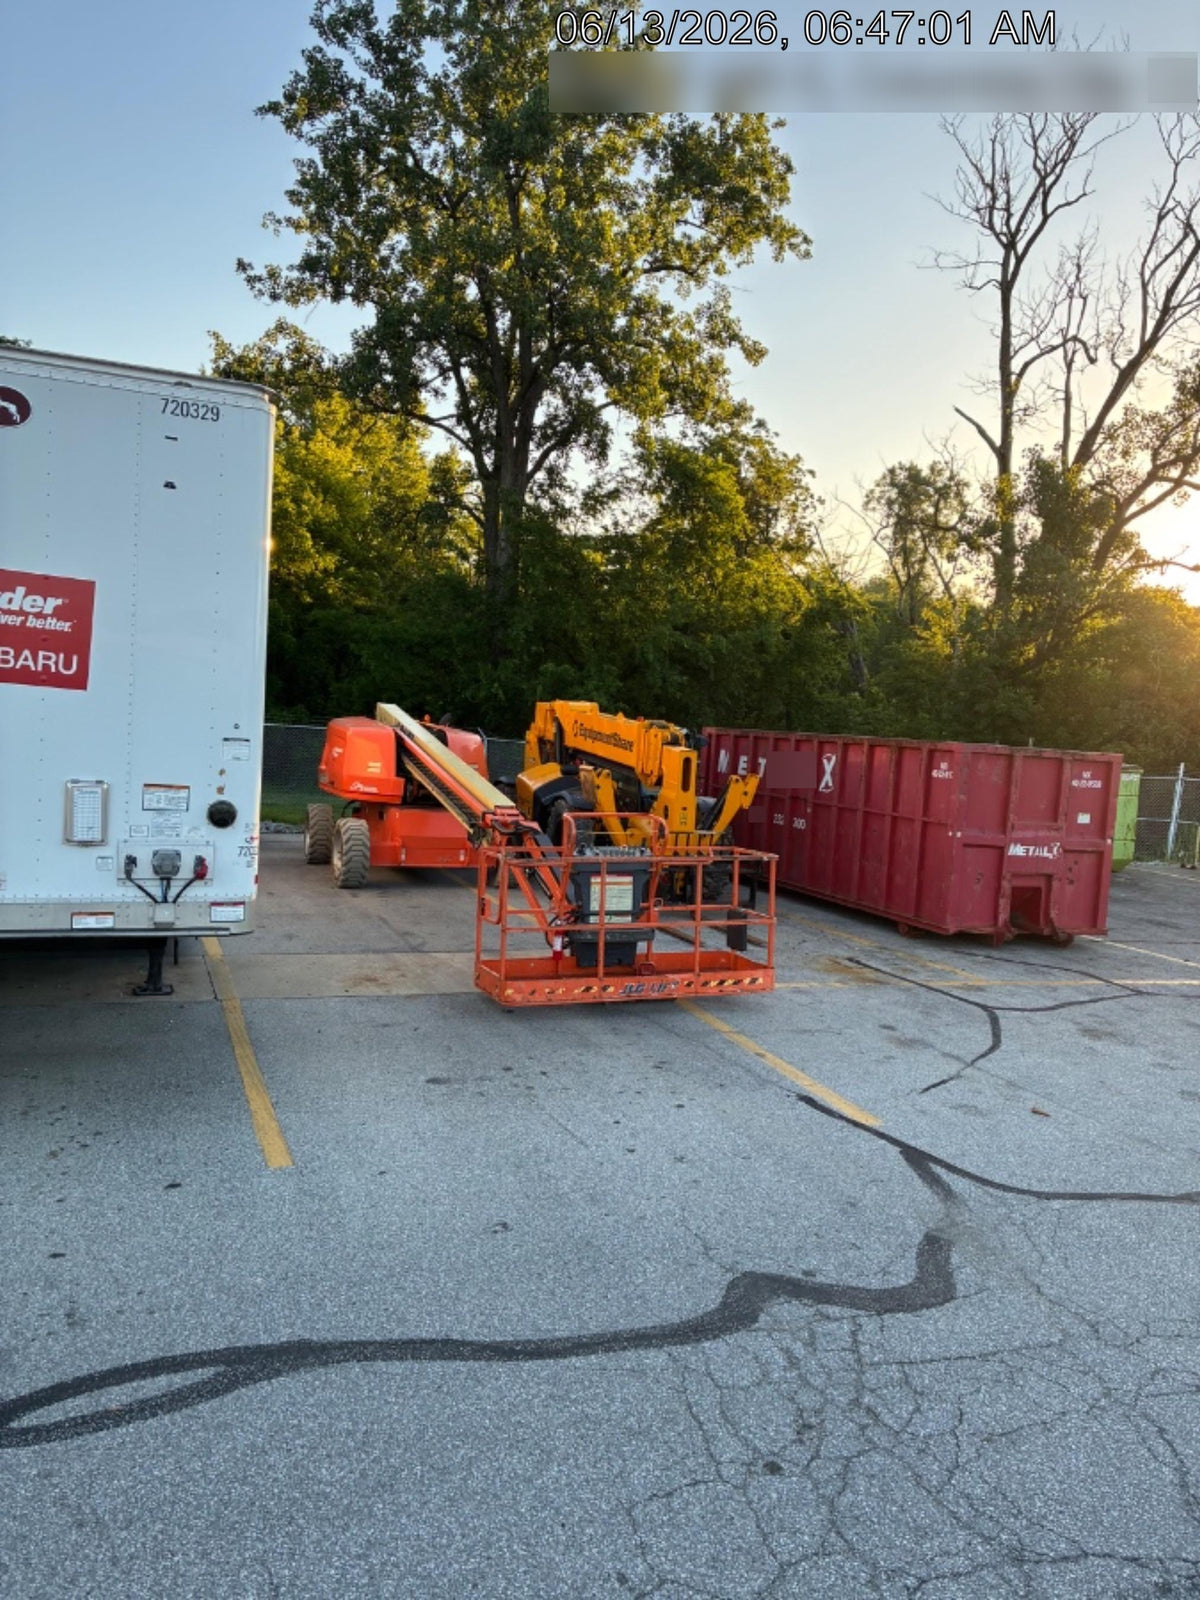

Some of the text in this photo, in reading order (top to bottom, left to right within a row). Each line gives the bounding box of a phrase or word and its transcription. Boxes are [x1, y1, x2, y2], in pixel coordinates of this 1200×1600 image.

[160, 397, 220, 423] 720329
[0, 586, 63, 615] der
[26, 614, 73, 632] better.
